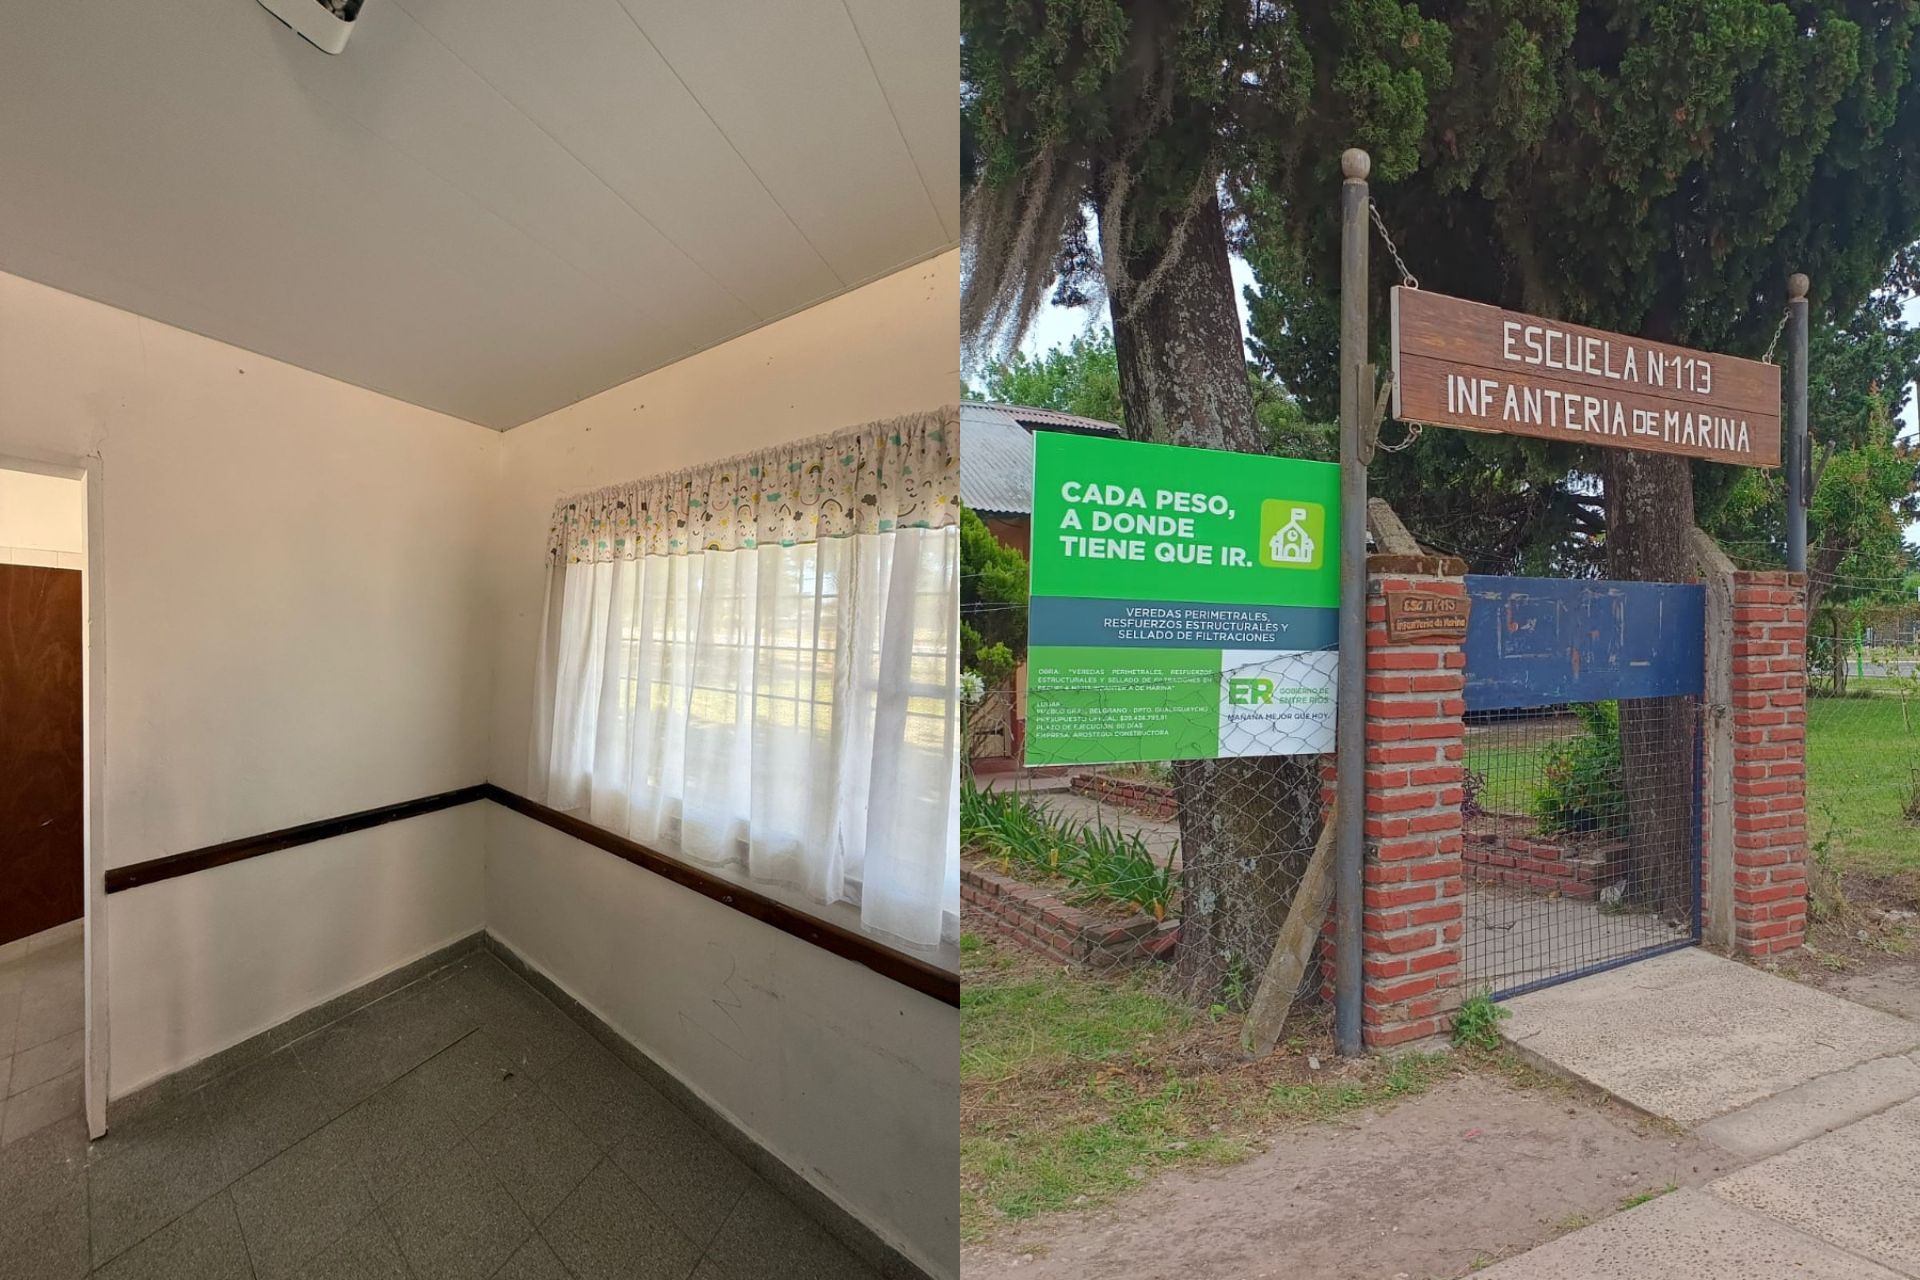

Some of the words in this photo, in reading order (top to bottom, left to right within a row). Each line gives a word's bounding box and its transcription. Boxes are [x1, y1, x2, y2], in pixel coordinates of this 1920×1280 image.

[1502, 321, 1639, 383] ESCUELA
[1447, 374, 1628, 437] INFANTERIA
[1631, 408, 1660, 436] DE
[1663, 409, 1751, 453] MARINA
[1061, 481, 1148, 509] CADA
[1155, 489, 1237, 520] PESO,
[1059, 508, 1083, 530] A
[1091, 510, 1195, 539] DONDE
[1058, 535, 1146, 561] TIENE
[1154, 542, 1214, 566] QUE
[1220, 546, 1254, 568] IR.
[1103, 618, 1183, 630] RESFUERZOS
[1185, 620, 1279, 632] ESTRUCTURALES
[1280, 623, 1289, 632] Y
[1126, 607, 1182, 619] VEREDAS
[1184, 610, 1271, 622] PERIMETRALES,
[1118, 630, 1174, 640] SELLADO
[1177, 631, 1193, 641] DE
[1195, 632, 1276, 642] FILTRACIONES
[1228, 677, 1274, 704] ER
[1227, 712, 1264, 721] MAÑANA
[1293, 712, 1310, 720] QUE
